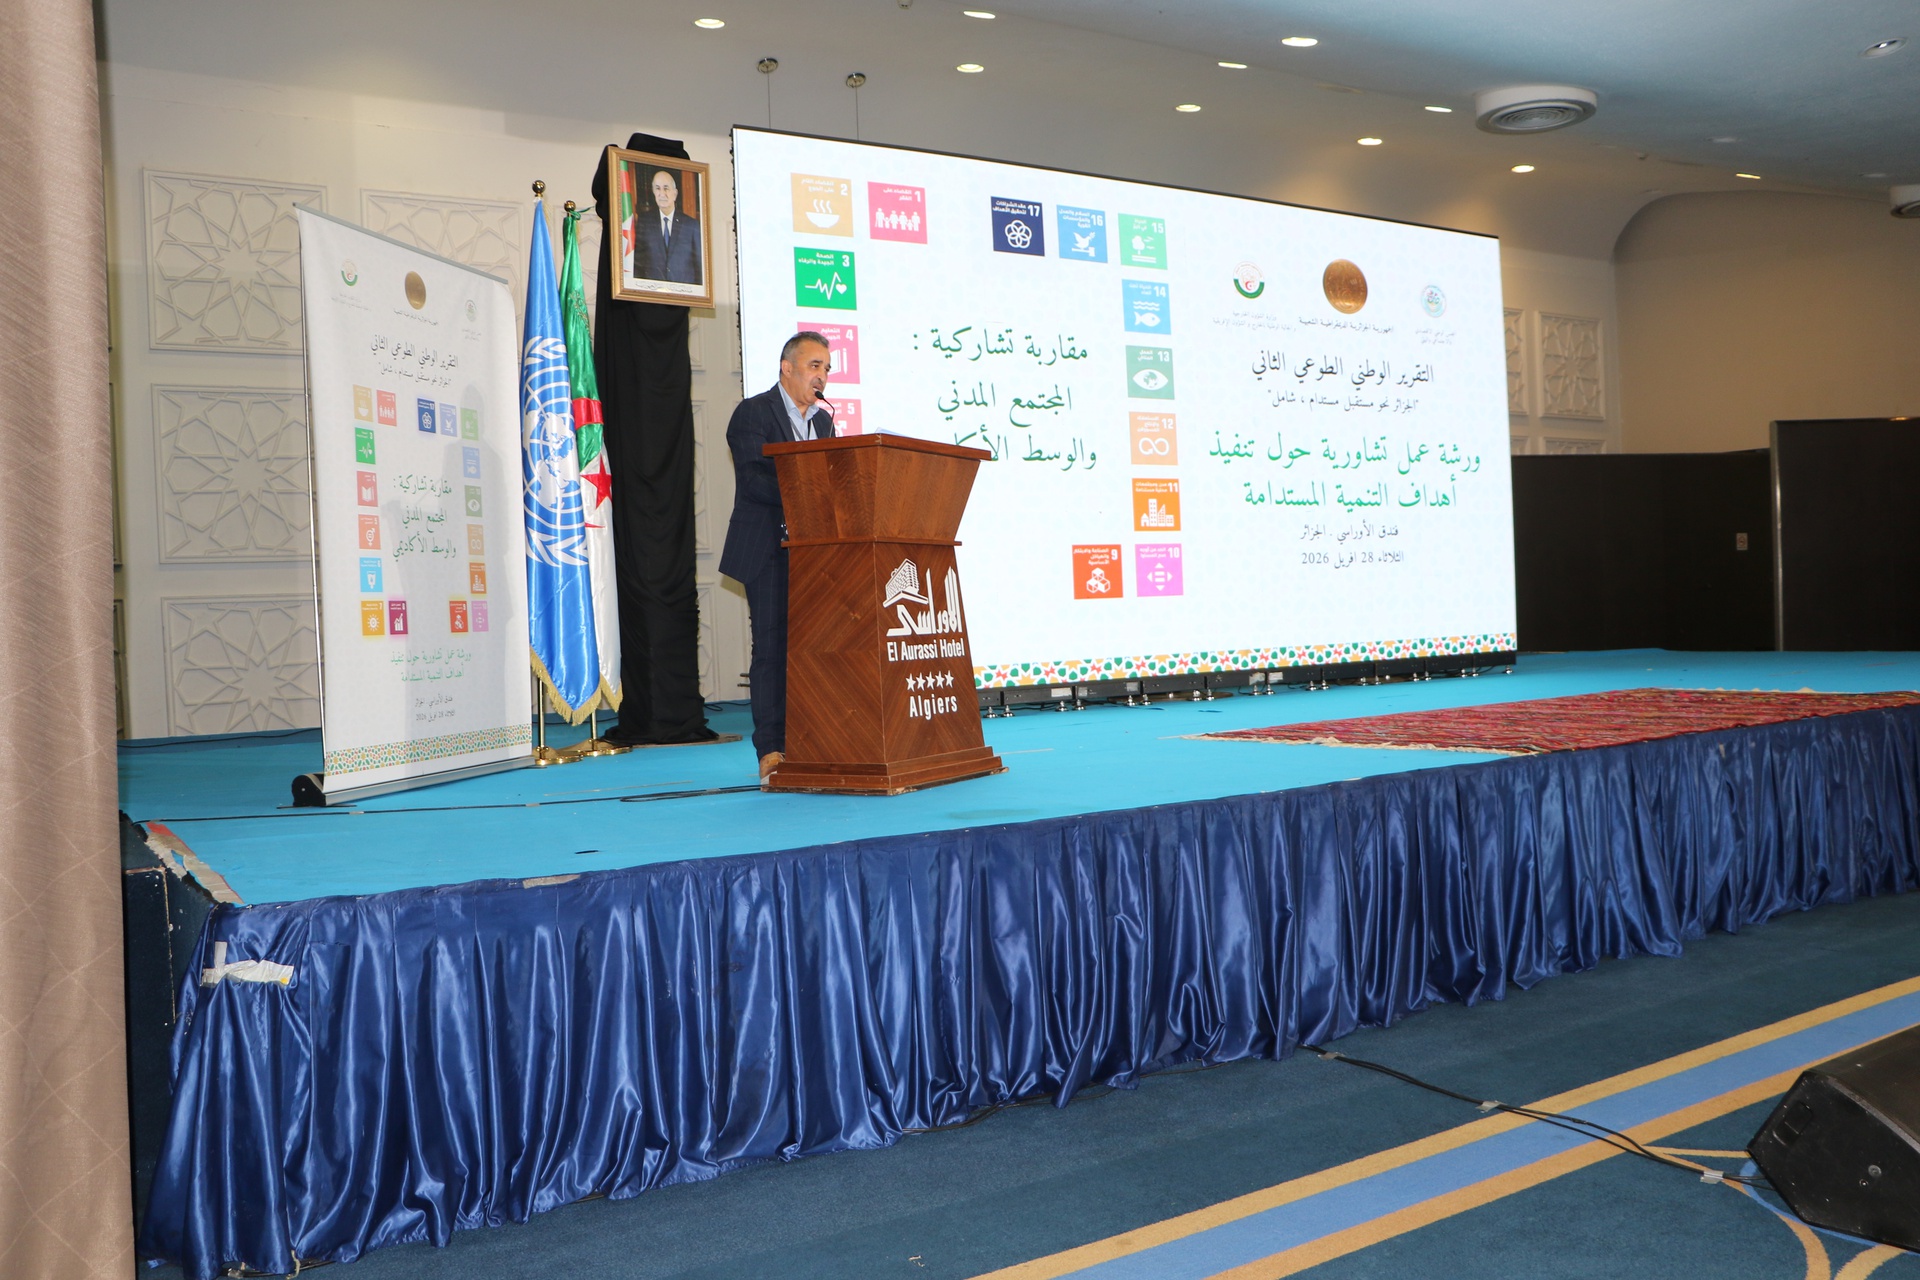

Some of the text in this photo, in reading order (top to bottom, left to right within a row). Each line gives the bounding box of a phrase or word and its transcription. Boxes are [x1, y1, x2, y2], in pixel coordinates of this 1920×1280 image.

[840, 183, 849, 196] 2
[914, 190, 922, 202] 1
[1027, 205, 1040, 217] 17
[1090, 215, 1103, 226] 16
[1151, 222, 1164, 234] 15
[842, 255, 850, 267] 3
[1153, 286, 1166, 297] 14
[846, 329, 854, 341] 4
[930, 326, 1014, 361] تشاركية
[1024, 334, 1088, 366] مقاربة
[1157, 350, 1169, 362] 13
[1252, 349, 1434, 391] التقرير الوطني الطوعي الثاني
[847, 402, 855, 414] 5
[938, 380, 1072, 428] المجتمع المدني
[1309, 393, 1339, 411] مستدام
[1344, 395, 1374, 411] مستقبل
[1377, 396, 1389, 412] نحو
[1162, 418, 1173, 429] 12
[1022, 434, 1097, 471] والوسط
[1209, 430, 1481, 475] ورشة عمل تشاورية حول تنفيذ
[1168, 482, 1178, 493] 11
[1243, 473, 1457, 513] أهداف التنمية المستدامة
[1300, 523, 1326, 540] الجزائر
[1336, 519, 1375, 545] الأوراسي
[1378, 523, 1399, 539] فندق
[1111, 549, 1118, 560] 9
[1168, 547, 1180, 558] 10
[1301, 552, 1330, 564] 2026
[1361, 552, 1374, 563] 28
[1378, 551, 1405, 564] الثلاثاء
[886, 638, 965, 662] El Aurassi Hotel
[909, 693, 958, 720] Algiers
